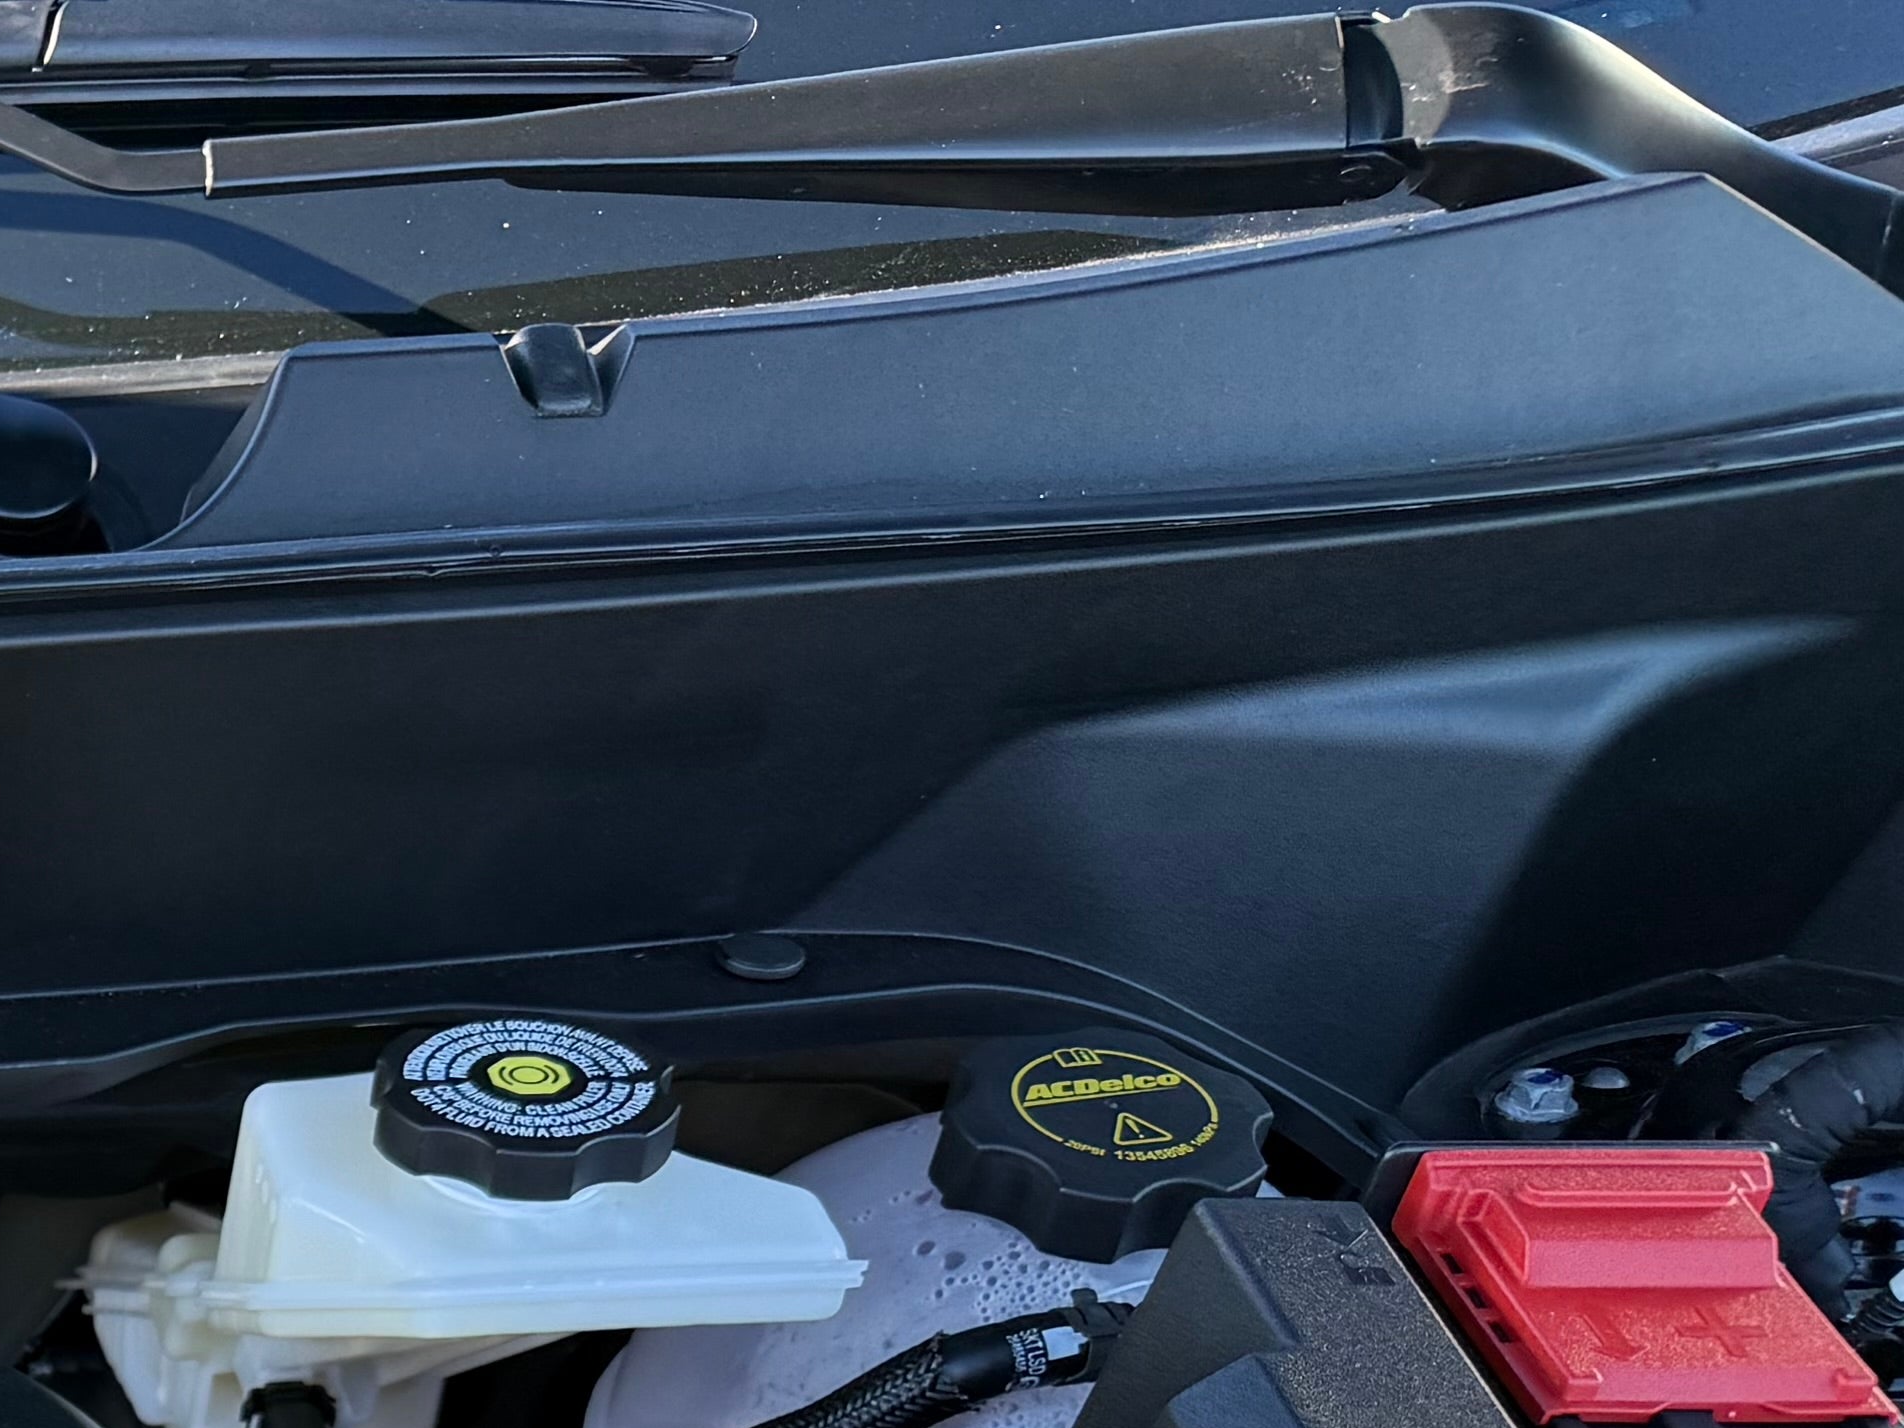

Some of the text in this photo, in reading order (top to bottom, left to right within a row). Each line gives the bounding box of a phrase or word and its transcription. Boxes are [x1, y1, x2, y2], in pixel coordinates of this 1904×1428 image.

[503, 1032, 556, 1044] LIQUIDE
[505, 1021, 574, 1035] BOUCHON
[1026, 1073, 1182, 1101] ACDelco
[433, 1085, 461, 1101] CAP
[452, 1099, 512, 1124] BEFORE
[525, 1101, 579, 1116] CLEAN
[437, 1106, 485, 1128] FLUID
[484, 1121, 534, 1137] FROM
[536, 1127, 550, 1138] A
[550, 1117, 612, 1138] SEALED
[1027, 1350, 1047, 1375] LSD
